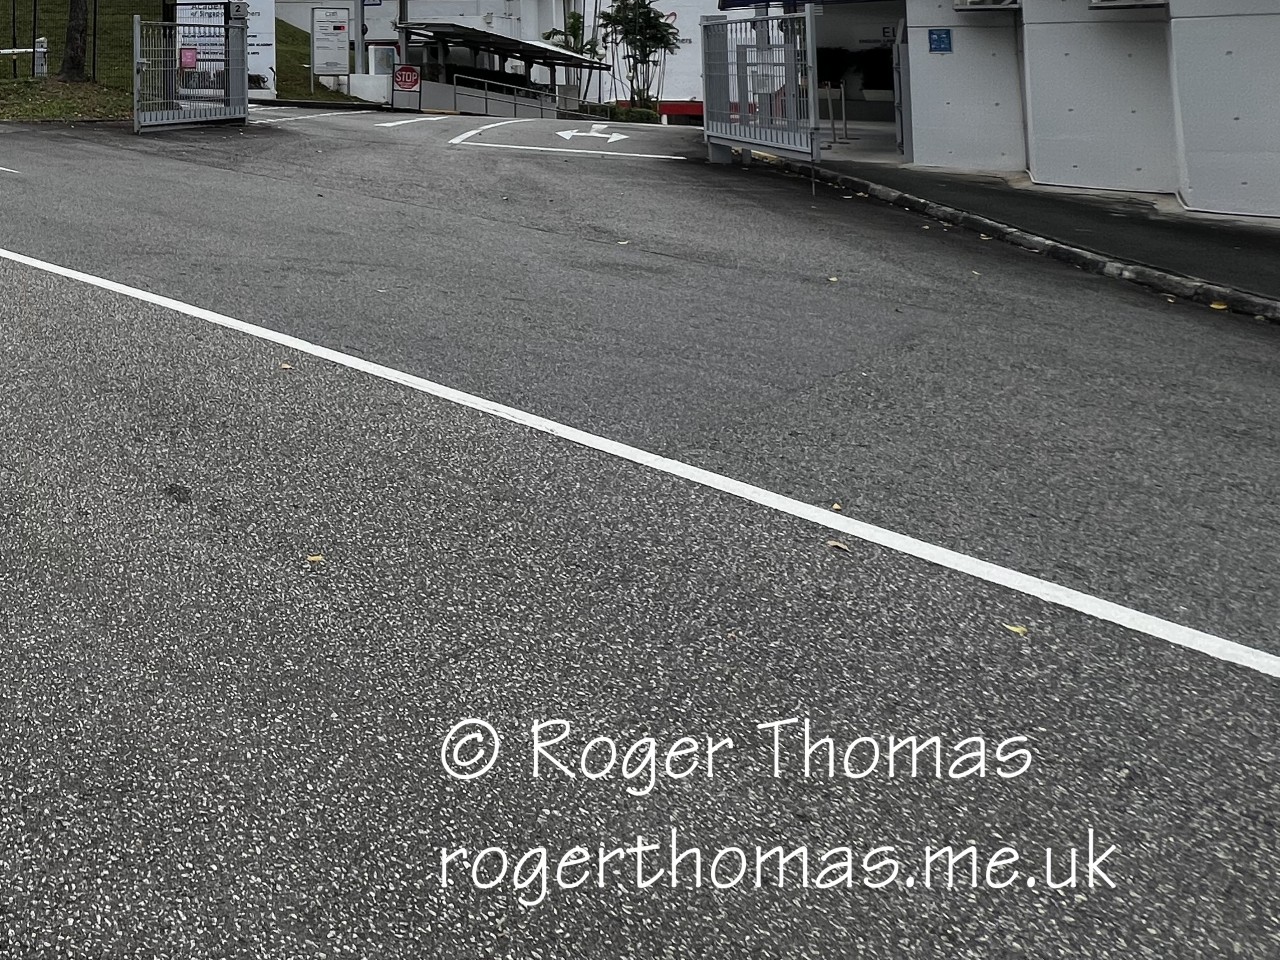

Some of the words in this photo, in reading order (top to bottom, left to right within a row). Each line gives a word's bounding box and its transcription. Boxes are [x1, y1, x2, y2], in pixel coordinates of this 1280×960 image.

[235, 4, 241, 12] 2
[882, 26, 896, 37] EL
[396, 71, 418, 82] STOP
